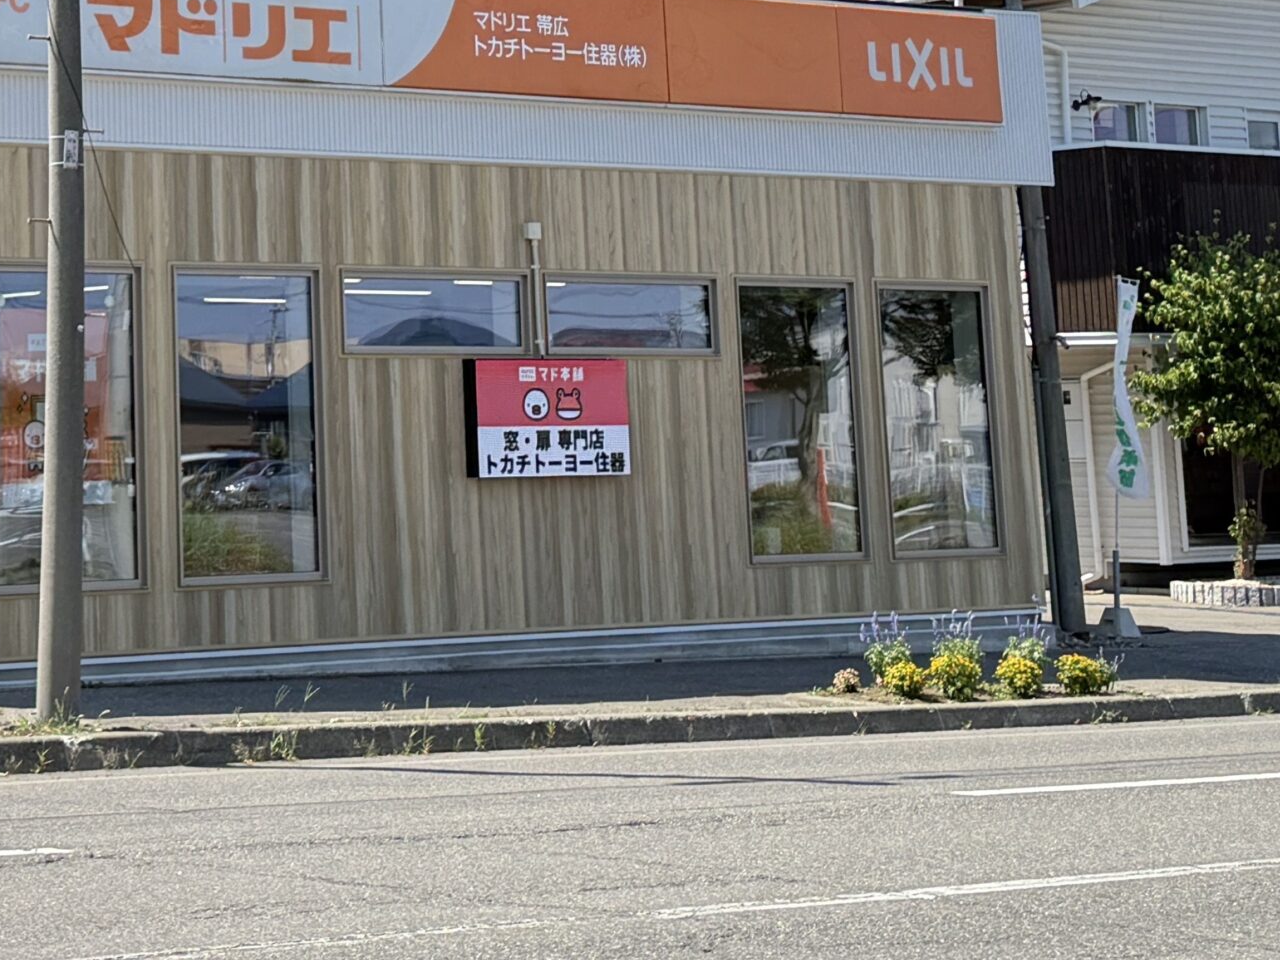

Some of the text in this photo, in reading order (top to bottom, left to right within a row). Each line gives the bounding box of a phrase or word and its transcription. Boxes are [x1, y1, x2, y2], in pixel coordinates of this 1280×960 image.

[473, 10, 569, 37] マドリエ 帯広
[474, 34, 647, 68] トカチトーヨー住器(株)
[867, 37, 974, 91] LIXIL
[538, 366, 584, 382] マド本舗
[504, 429, 604, 452] 窓・扉 専門店
[487, 452, 625, 475] トカチトーヨー住器
